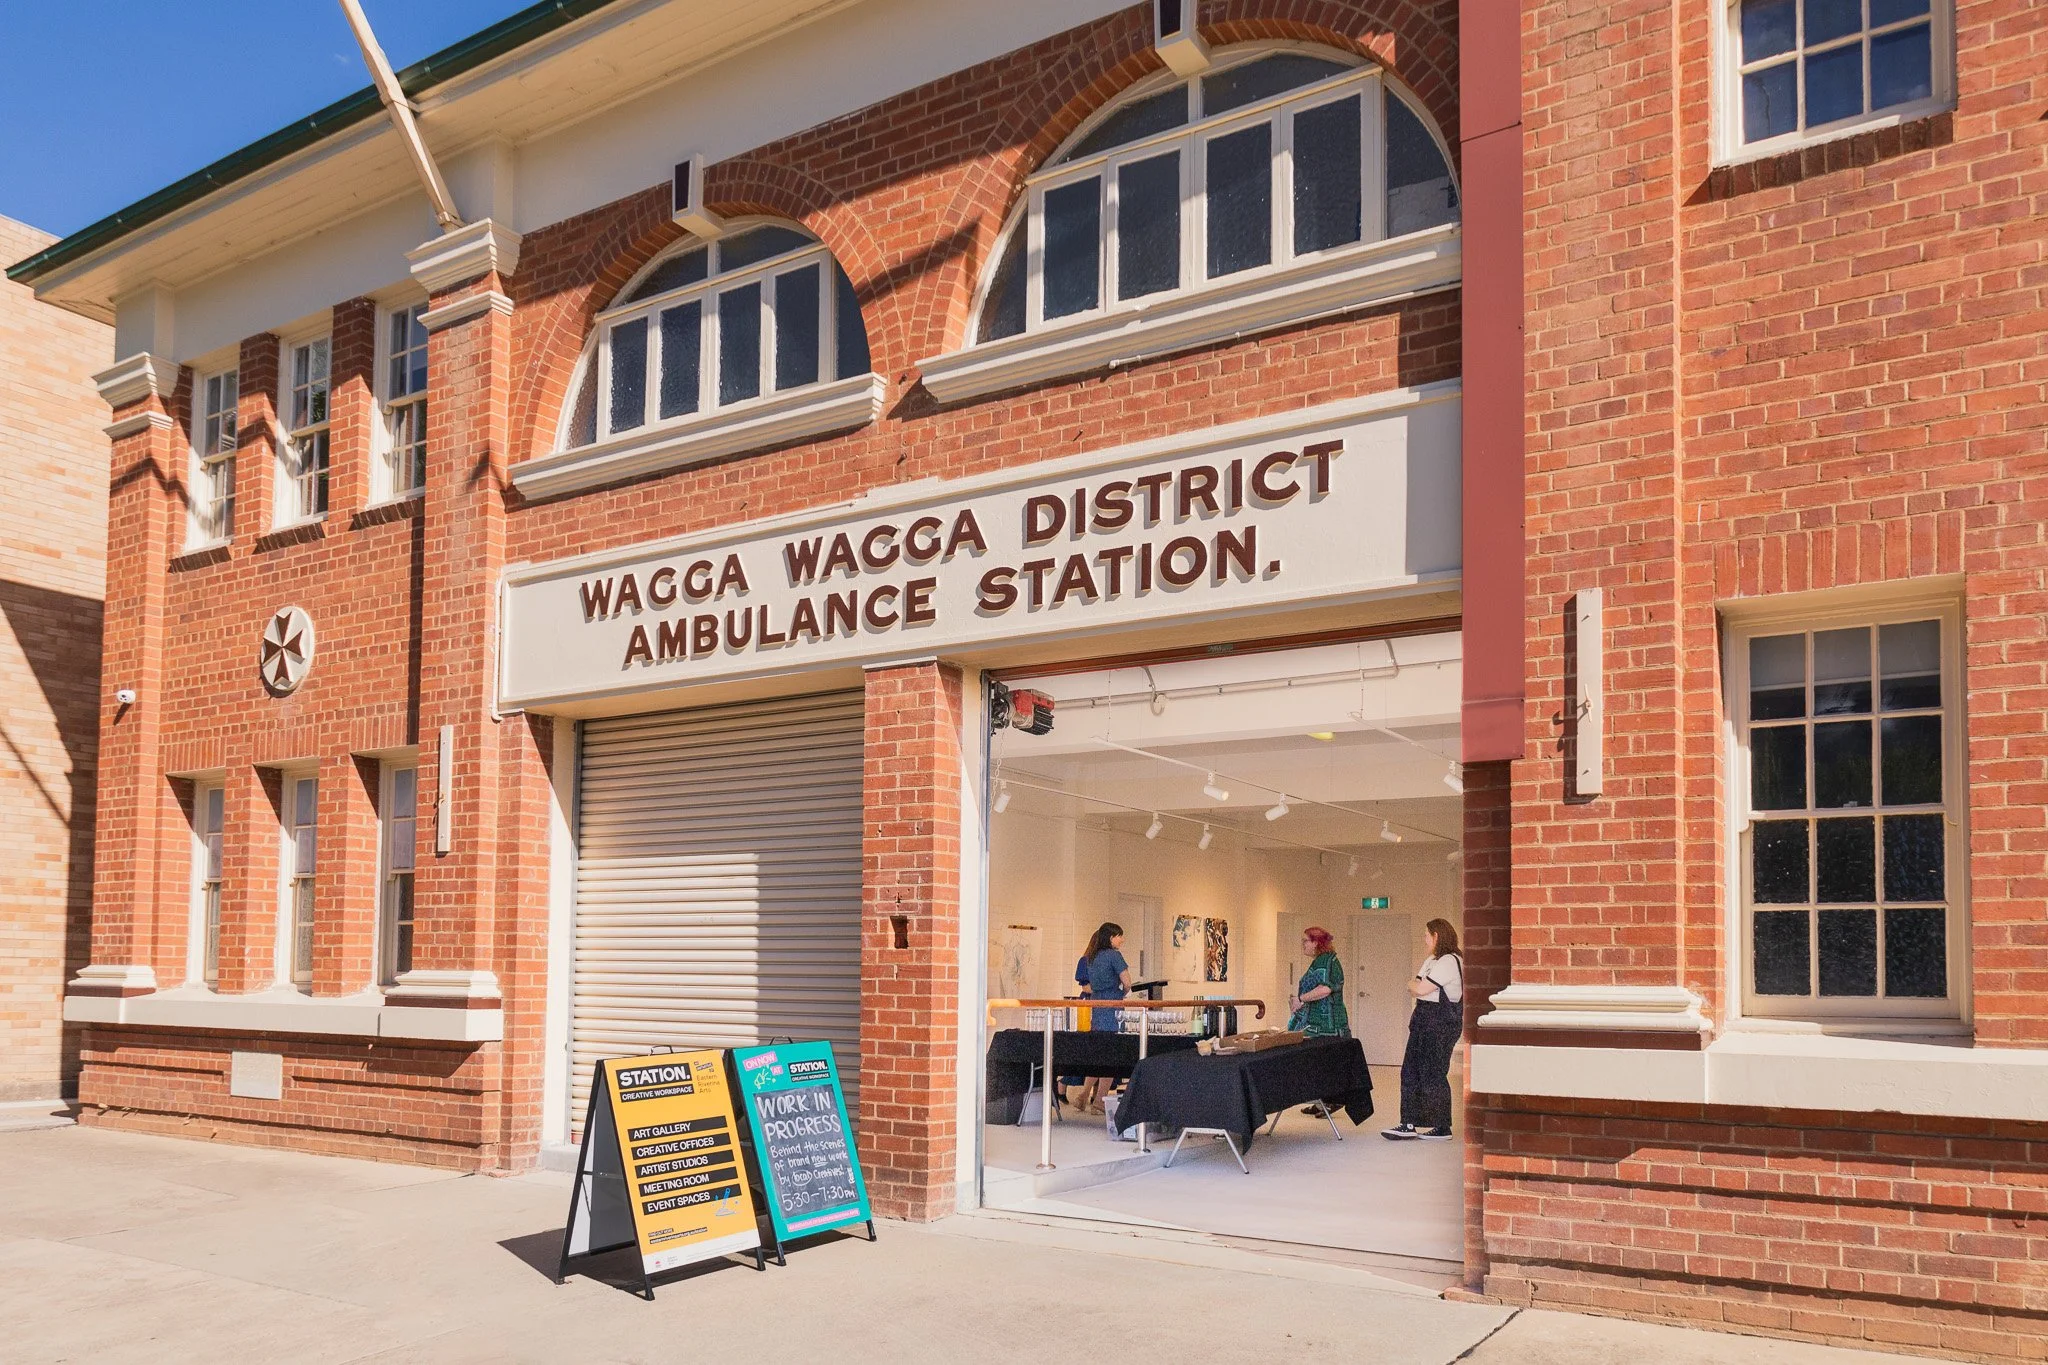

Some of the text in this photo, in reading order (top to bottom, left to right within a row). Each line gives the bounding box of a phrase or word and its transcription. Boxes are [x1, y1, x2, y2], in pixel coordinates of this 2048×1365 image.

[581, 439, 1344, 620] WAGGA WAGGA DISTRICT
[624, 525, 1281, 666] AMBULANCE STATION.
[745, 1054, 776, 1069] ON NOW
[772, 1066, 782, 1074] AT
[789, 1061, 828, 1073] STATION.
[620, 1066, 691, 1087] STATION.
[622, 1086, 693, 1100] CREATIVE WORKSPACE
[756, 1092, 831, 1119] WORK IN
[633, 1122, 691, 1139] ART GALLERY
[764, 1114, 841, 1143] PROGRESS
[636, 1137, 715, 1157] CREATIVE OFFICES
[770, 1138, 846, 1158] Behind the scenes
[641, 1156, 709, 1176] ARTIST STUDIOS
[774, 1151, 848, 1171] of brand new work
[643, 1174, 710, 1194] MEETING ROOM
[777, 1172, 791, 1187] by
[793, 1171, 811, 1182] local
[647, 1192, 711, 1212] EVENT SPACES
